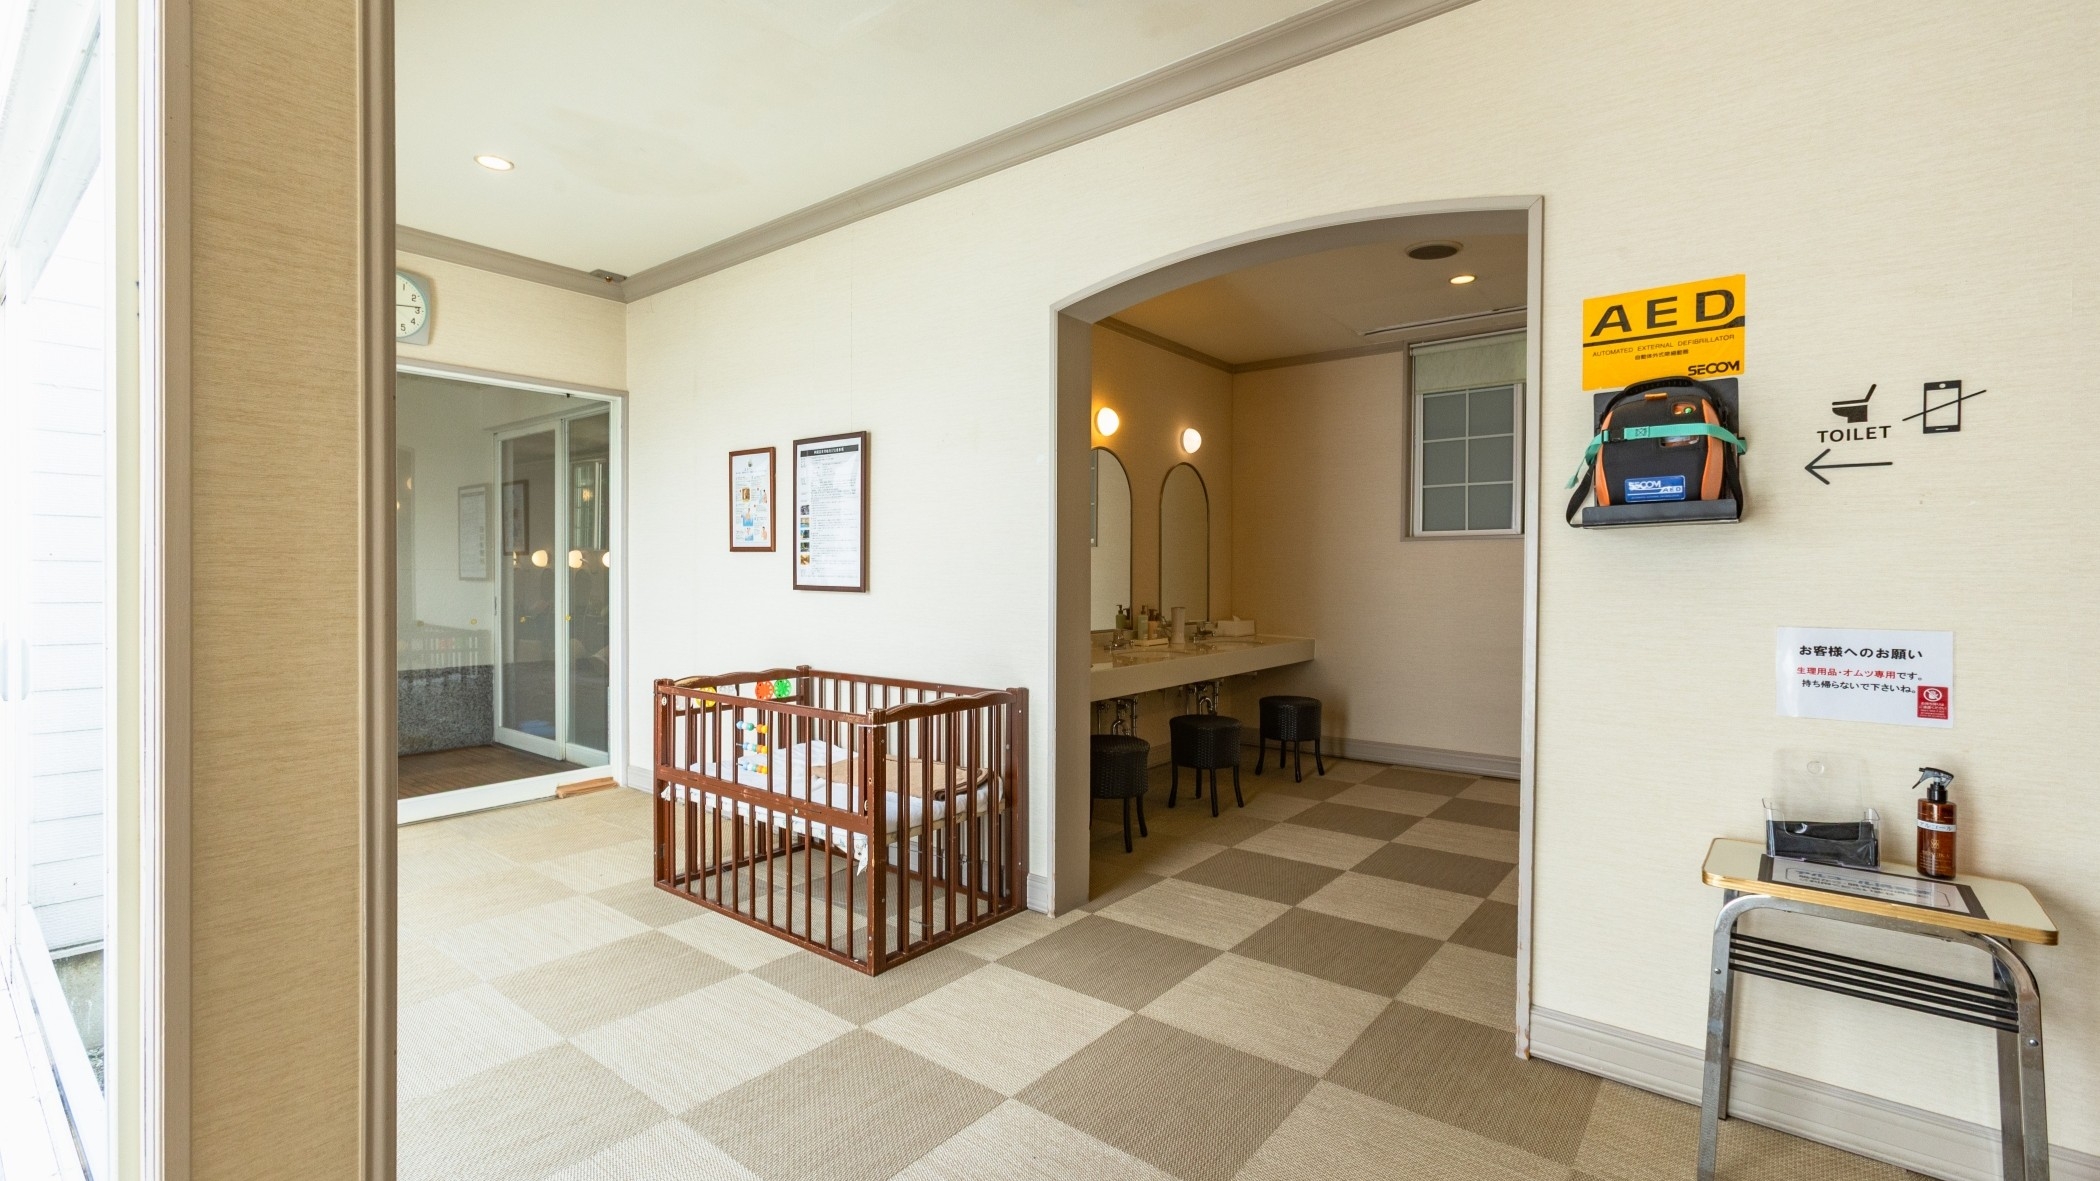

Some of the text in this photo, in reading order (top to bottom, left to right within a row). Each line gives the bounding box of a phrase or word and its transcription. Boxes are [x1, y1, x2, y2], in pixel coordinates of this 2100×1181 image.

[411, 294, 417, 302] 2
[1590, 289, 1735, 337] AED
[400, 323, 406, 331] 5
[1592, 334, 1735, 357] AUTOMATED EXTERNAL DEFIBRILLATOR
[1687, 360, 1740, 376] SECOM
[1816, 425, 1892, 443] TOILET
[1799, 645, 1923, 660] お客様へのお願い
[1801, 679, 1916, 694] 持ち帰らないで下さいね。
